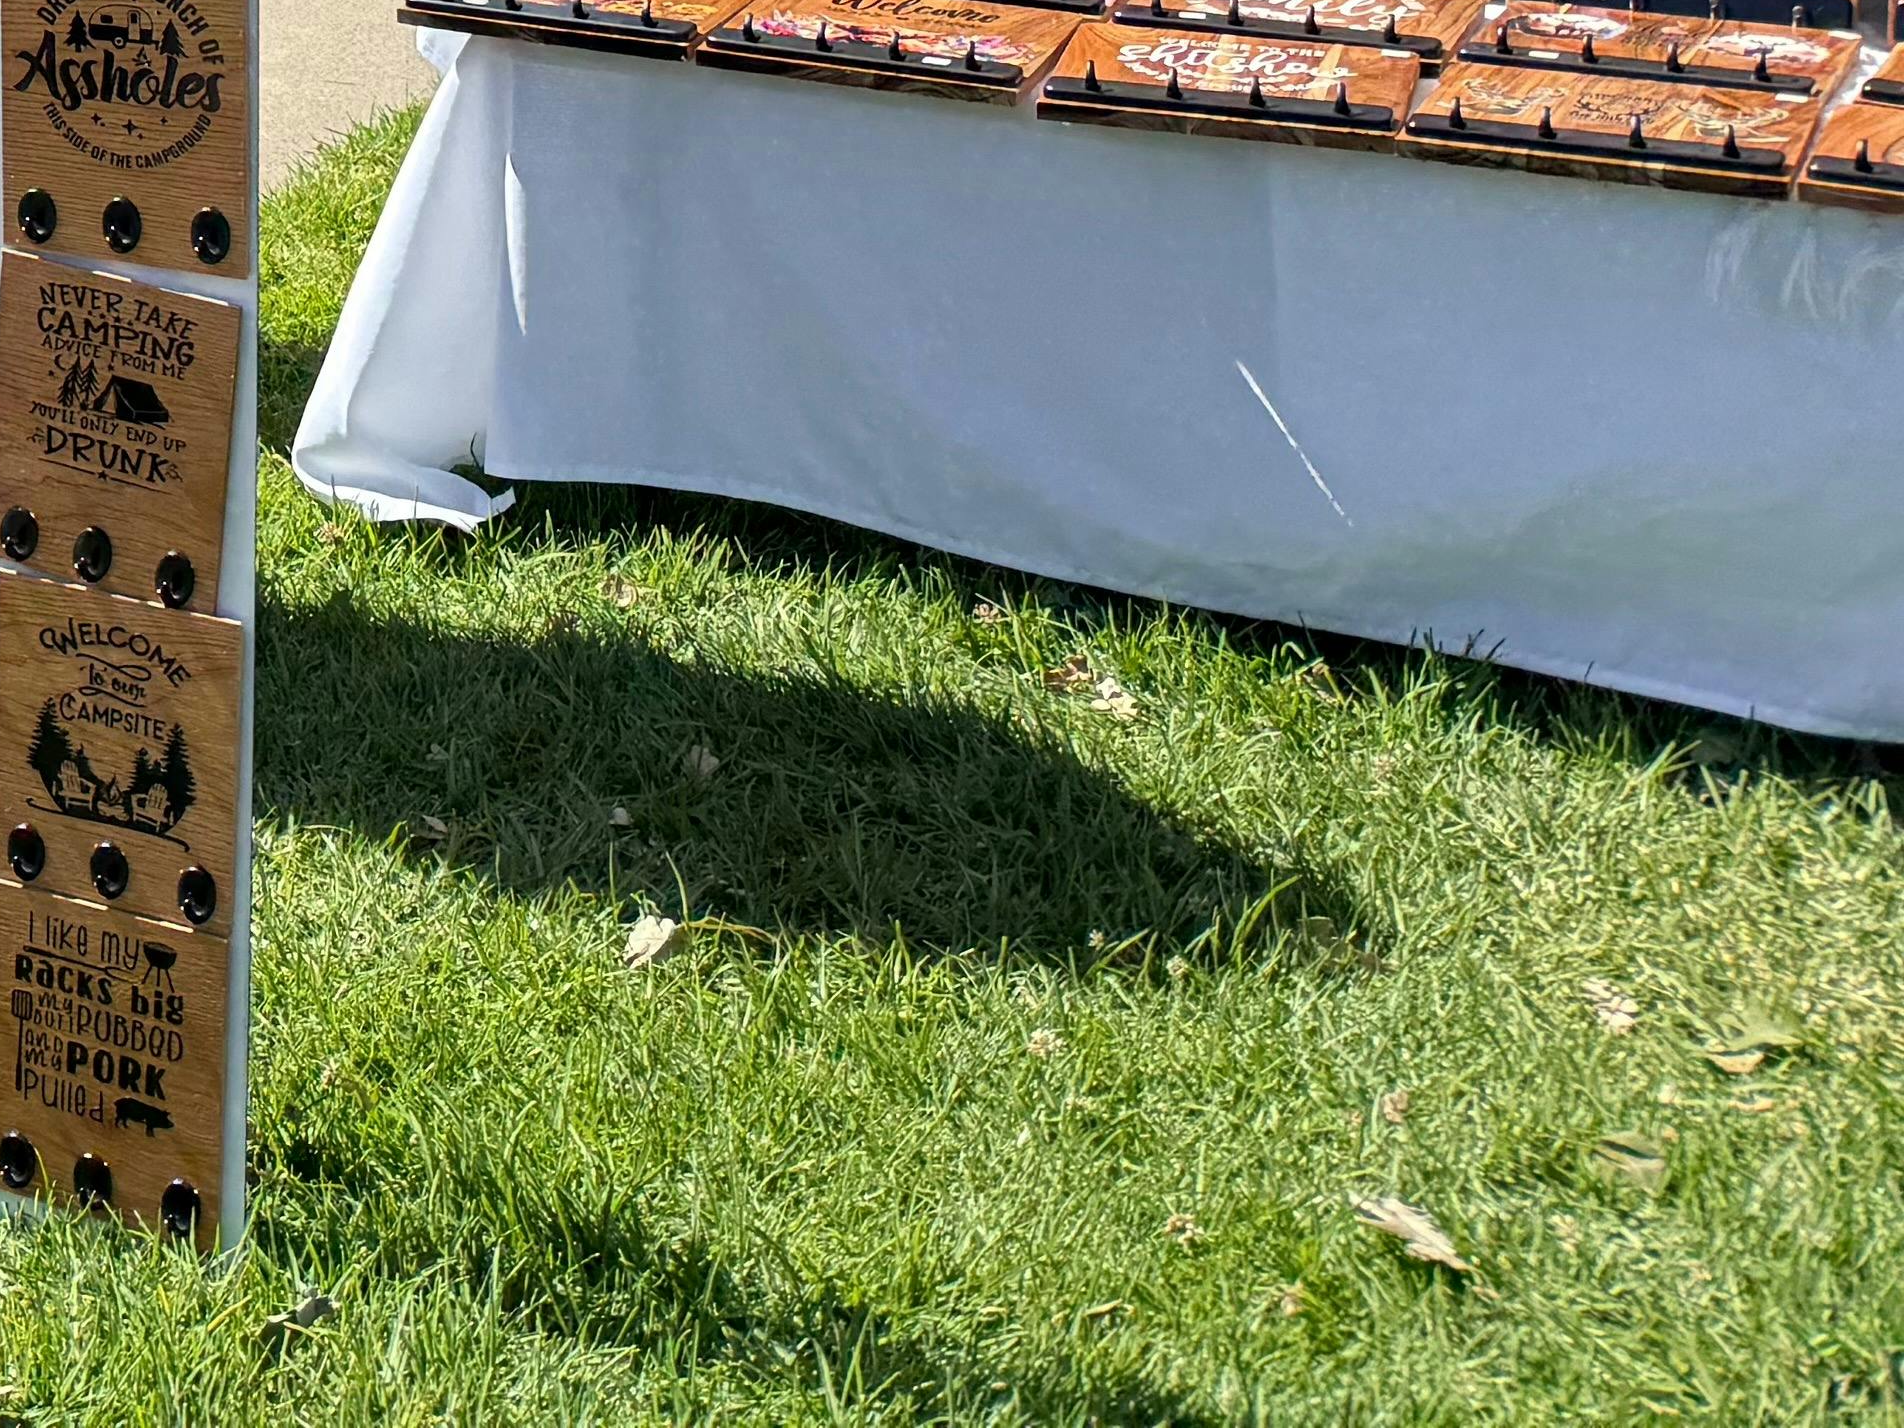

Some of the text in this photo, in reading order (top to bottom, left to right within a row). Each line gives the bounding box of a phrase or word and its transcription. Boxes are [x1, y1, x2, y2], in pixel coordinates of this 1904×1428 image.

[12, 29, 226, 113] Assholes
[198, 38, 225, 66] OF
[43, 100, 213, 170] THIS SIDE OF THE CAMPGROUND
[36, 306, 196, 368] CAMPING
[39, 281, 198, 340] NEVER TAKE
[41, 335, 188, 381] ADVICE FROM ME
[29, 399, 187, 454] YOU'LL ONLY END UP
[43, 423, 171, 484] DRUNK
[39, 616, 192, 688] WELCOME
[59, 693, 168, 742] CAMPSITE
[28, 910, 141, 971] I like my
[130, 985, 184, 1026] big
[66, 1039, 167, 1101] PORK
